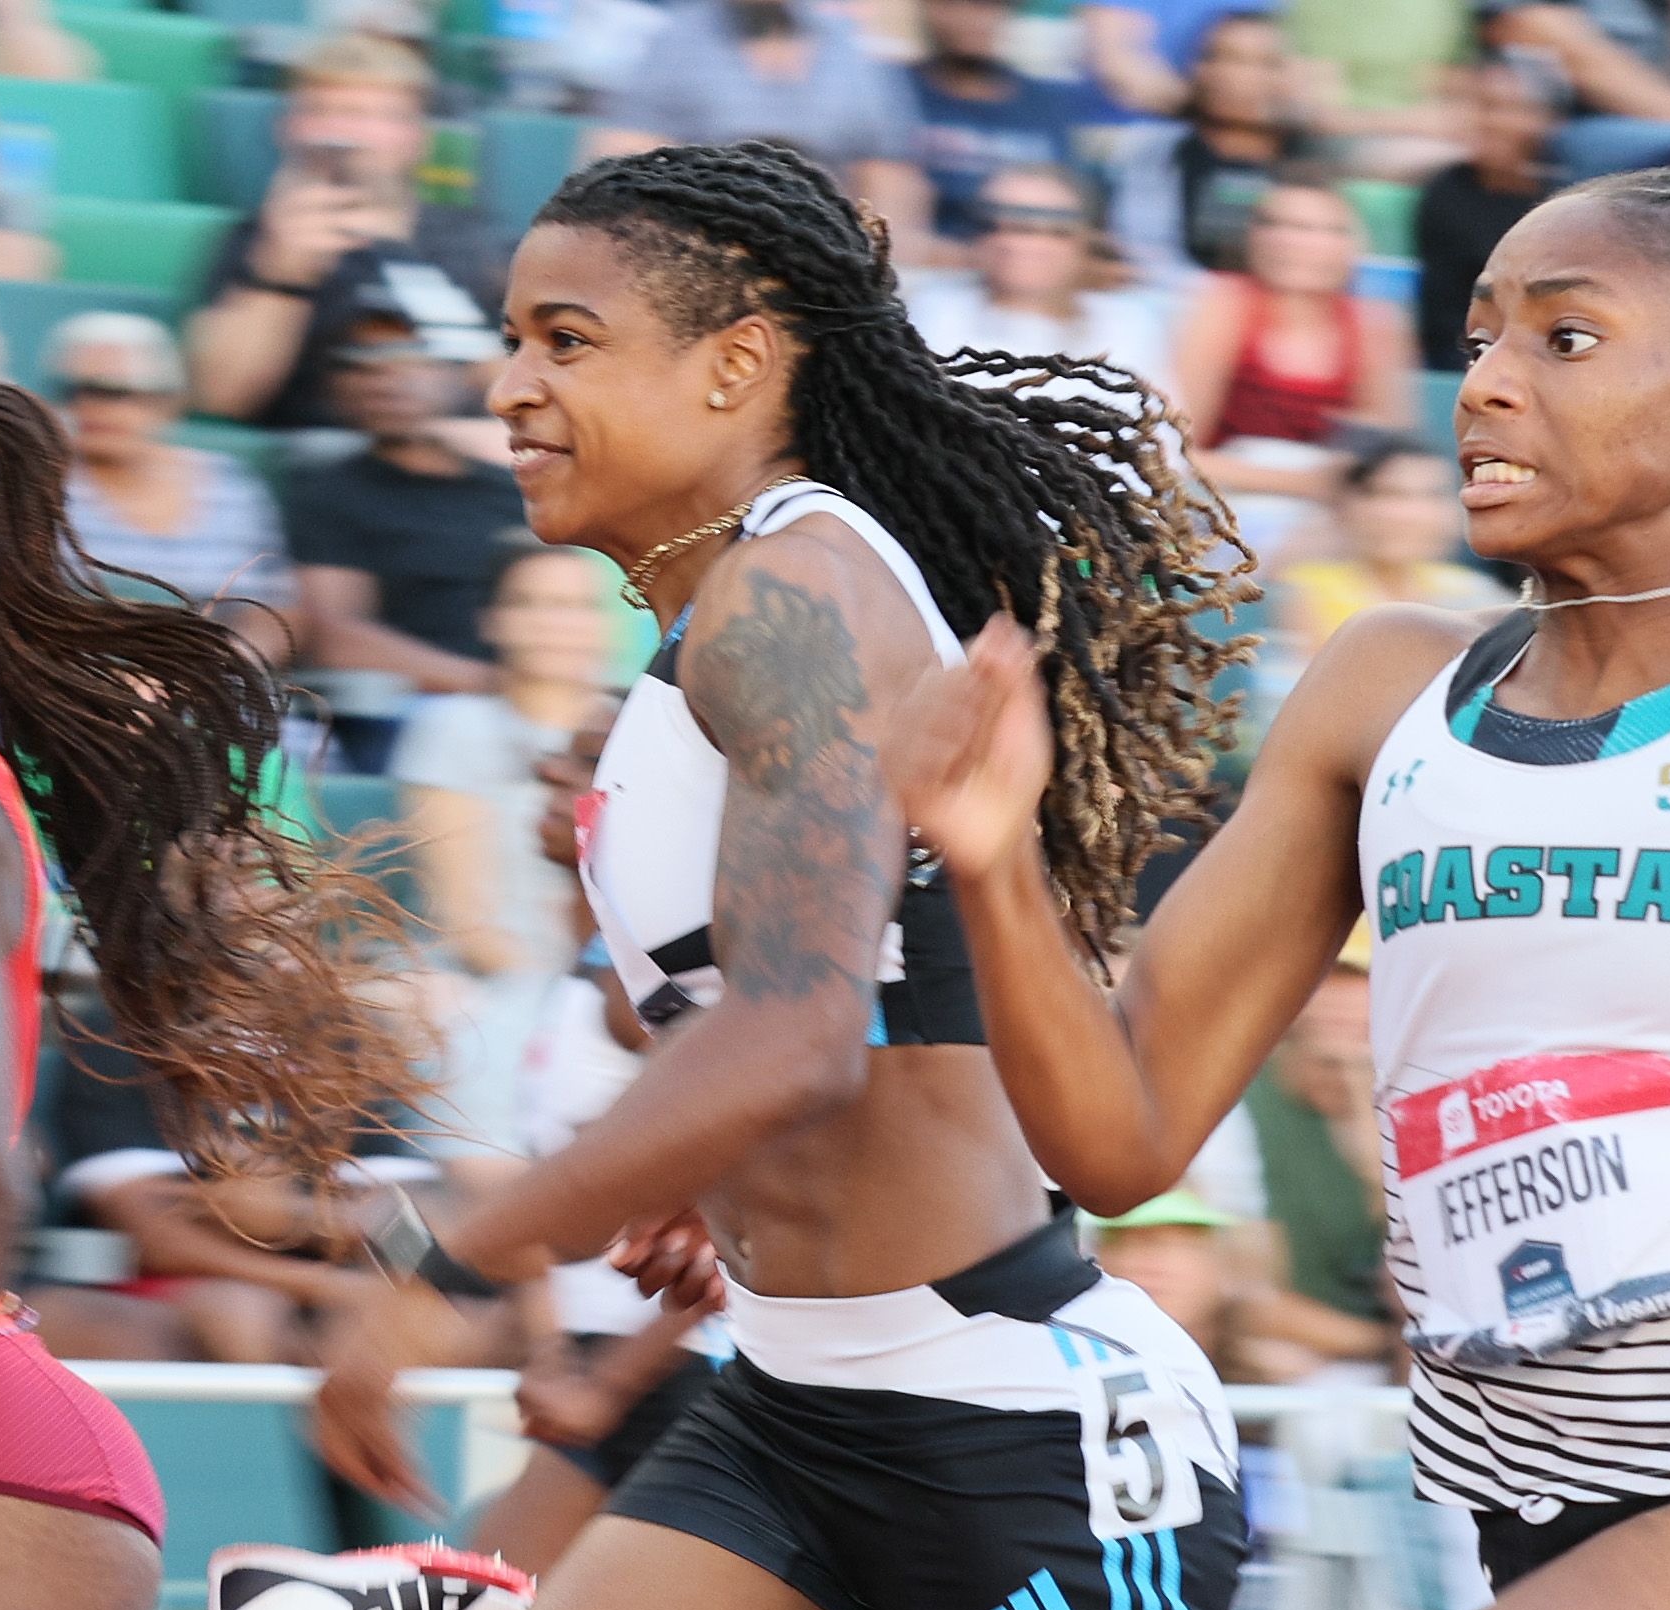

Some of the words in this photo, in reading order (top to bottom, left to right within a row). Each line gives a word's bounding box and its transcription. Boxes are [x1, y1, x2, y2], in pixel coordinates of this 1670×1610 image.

[1472, 1078, 1573, 1122] TOYOTA
[1436, 1132, 1629, 1248] JEFFERSON
[1101, 1370, 1165, 1522] 5
